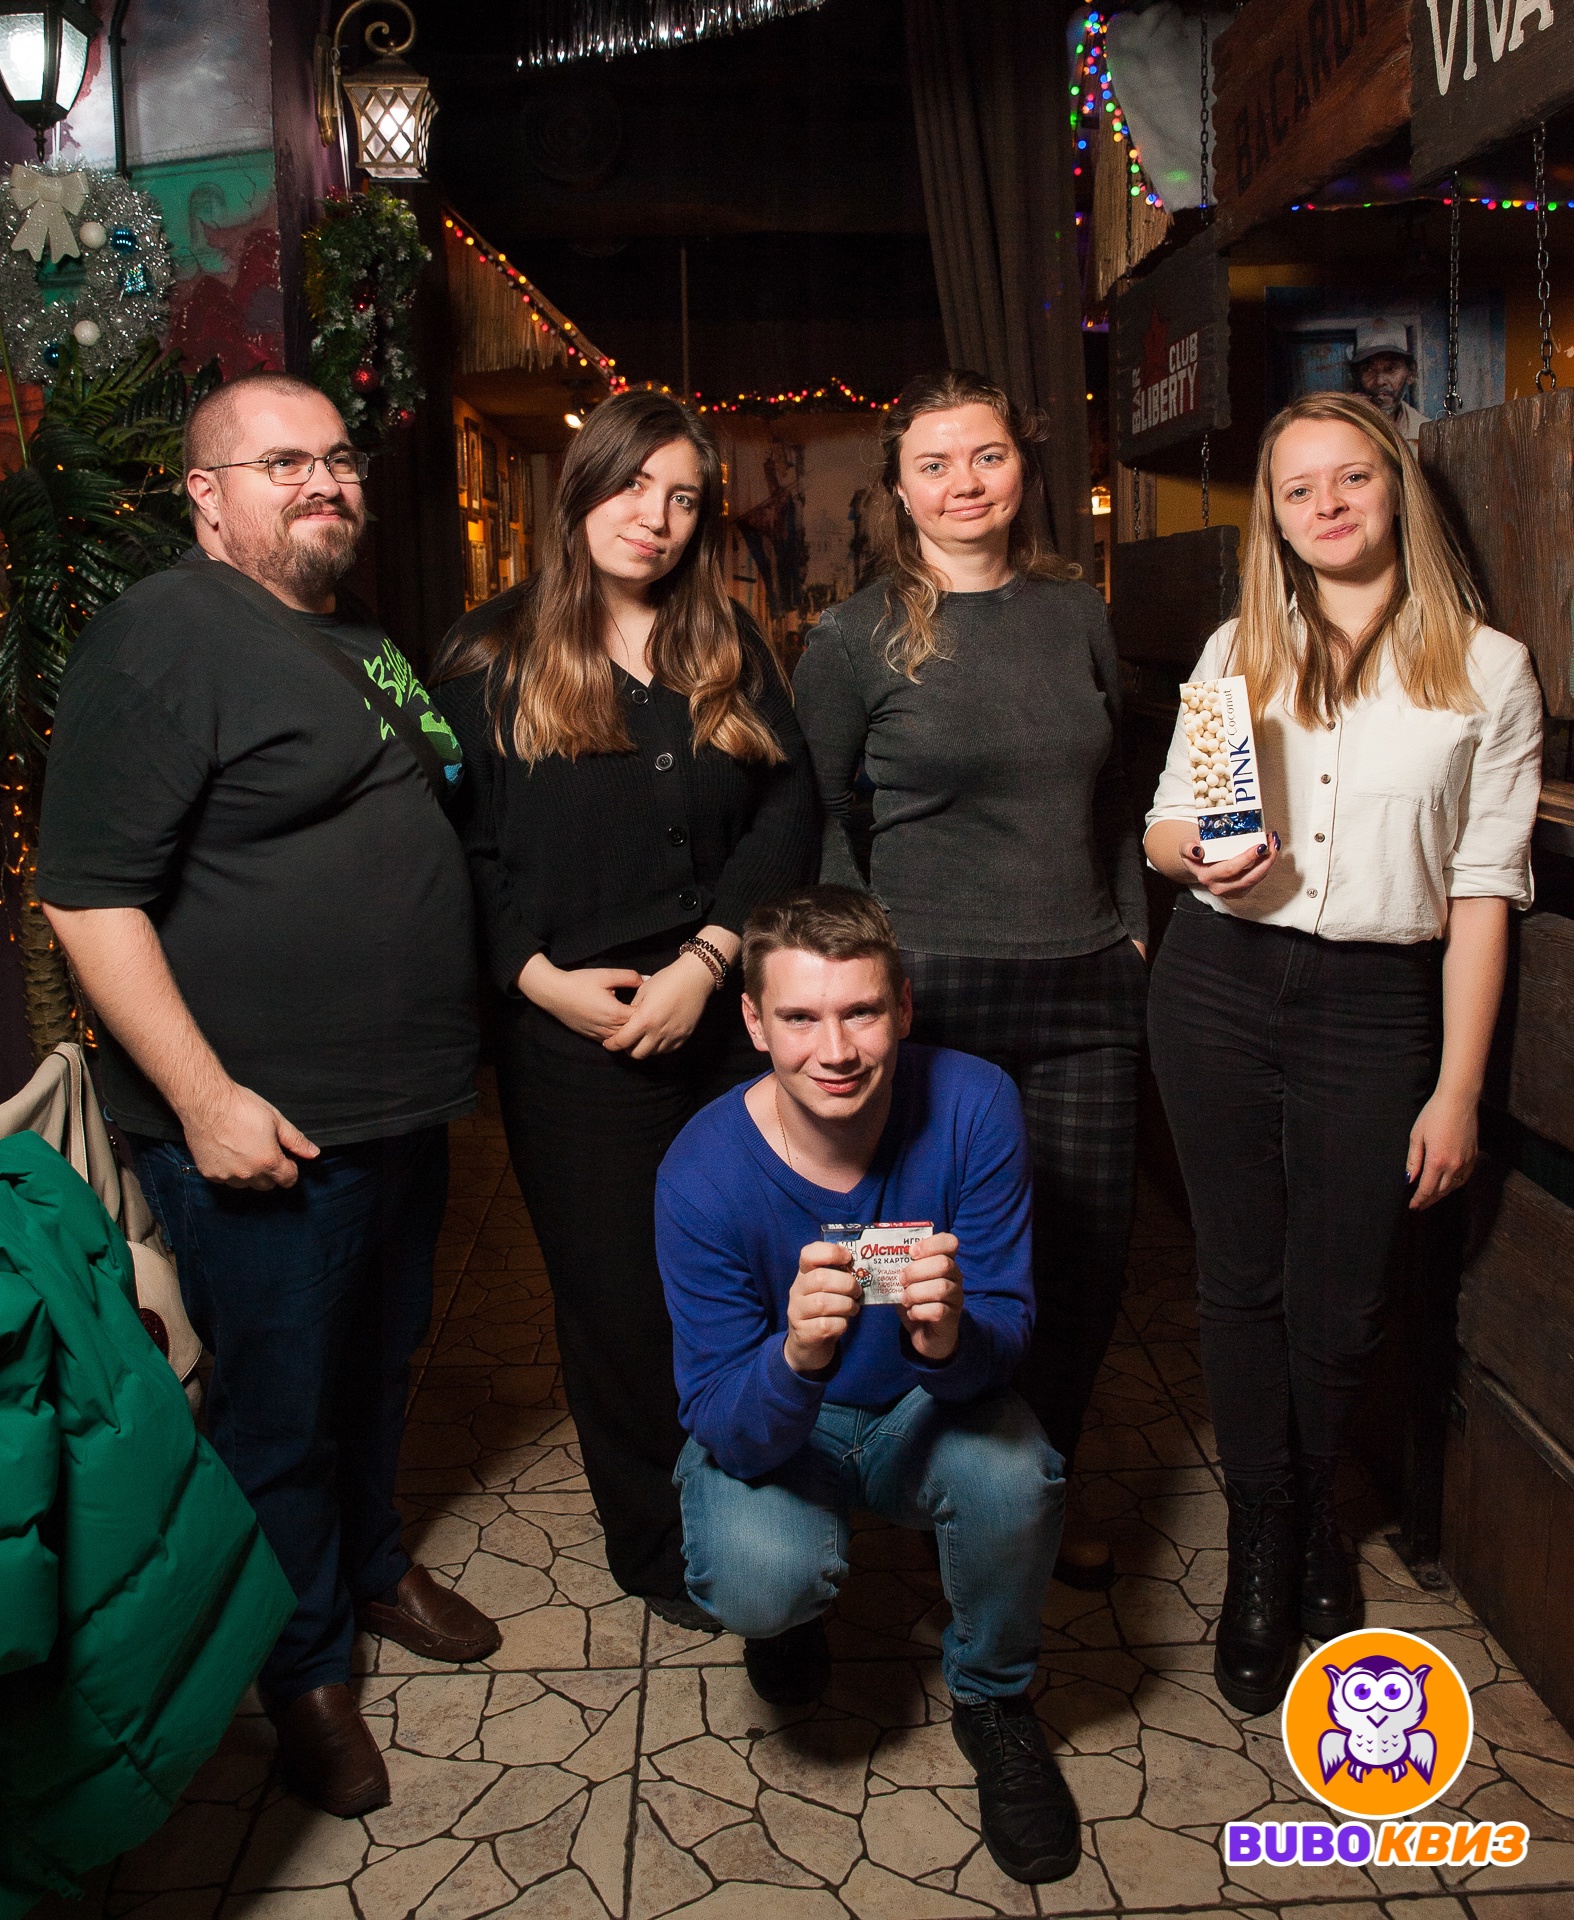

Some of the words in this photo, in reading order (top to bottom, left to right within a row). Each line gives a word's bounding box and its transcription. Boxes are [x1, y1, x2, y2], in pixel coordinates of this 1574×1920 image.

[1168, 332, 1199, 374] CLUB
[1140, 362, 1199, 432] LIBERTY
[1223, 688, 1237, 736] Coconut
[1227, 735, 1256, 804] PINK
[860, 1243, 910, 1260] Мстите
[883, 1256, 914, 1265] КАРТО
